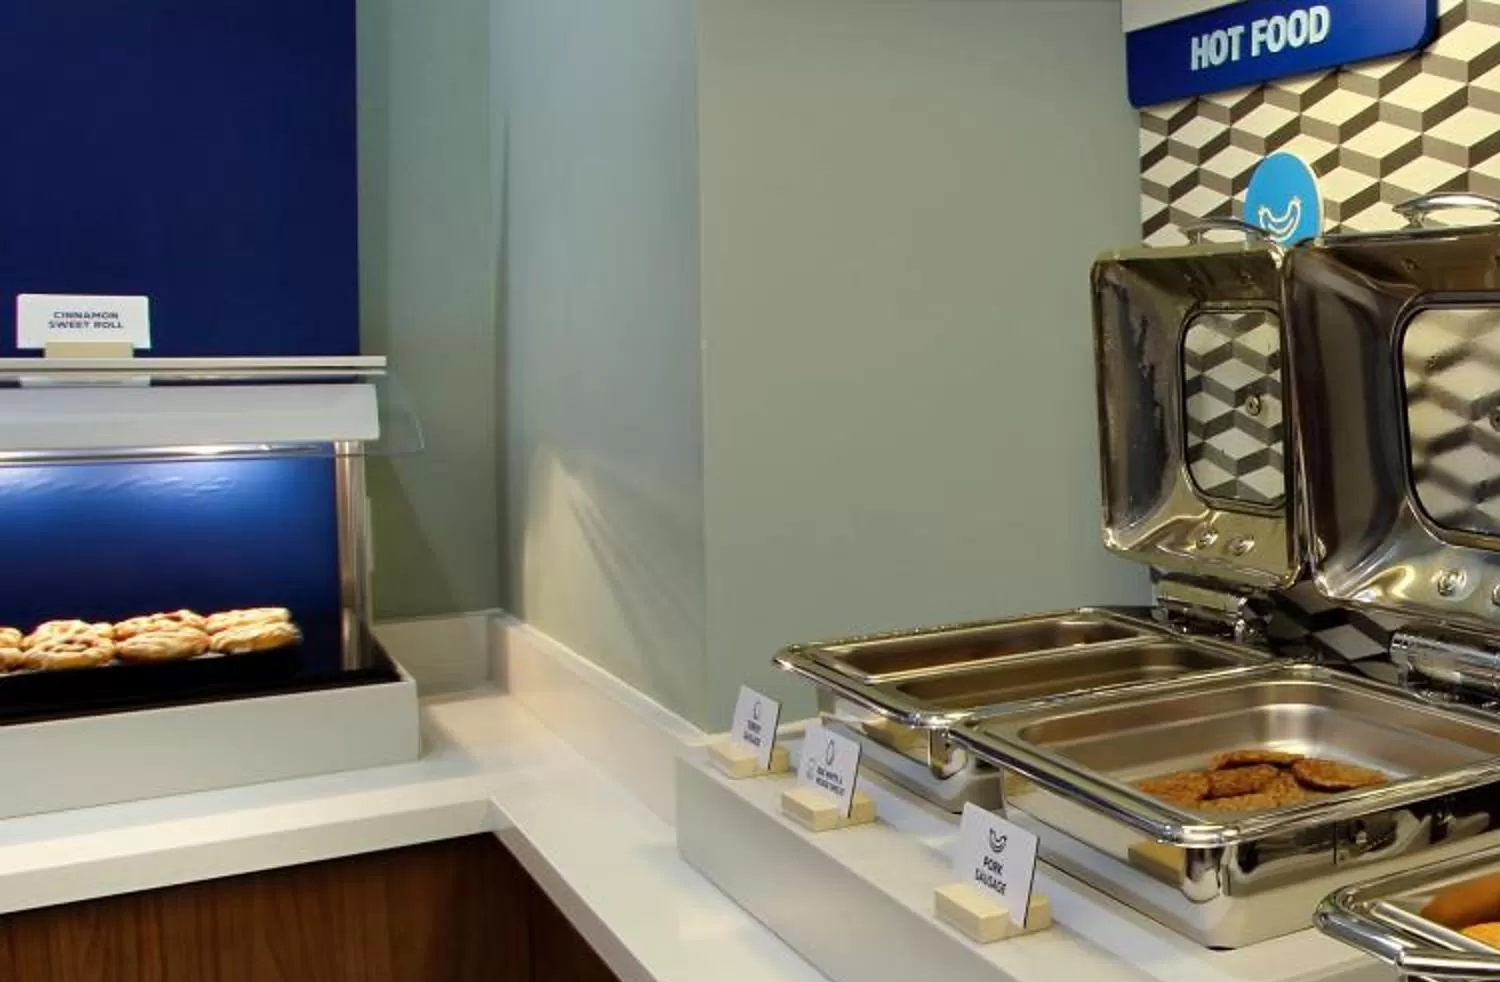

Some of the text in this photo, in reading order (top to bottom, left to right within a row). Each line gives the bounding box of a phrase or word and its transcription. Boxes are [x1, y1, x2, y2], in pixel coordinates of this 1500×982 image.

[1191, 5, 1330, 71] HOT FOOD
[48, 321, 124, 329] SWEET ROLL
[53, 311, 119, 319] CINNAMON
[983, 855, 1005, 877] PORK
[975, 866, 1007, 897] SAUSAGE
